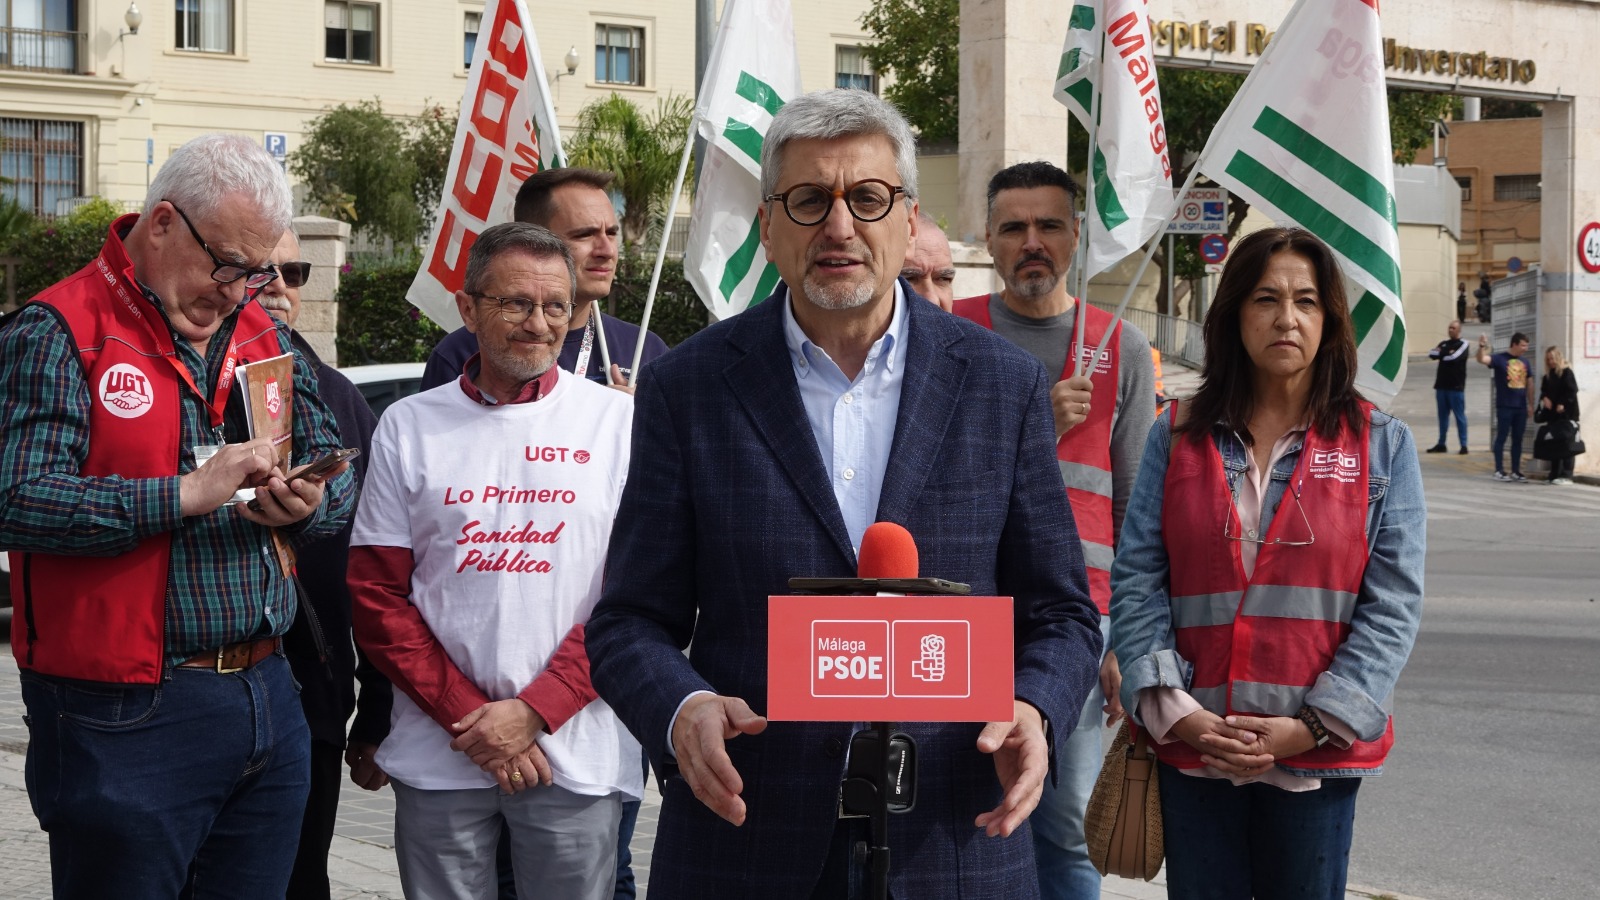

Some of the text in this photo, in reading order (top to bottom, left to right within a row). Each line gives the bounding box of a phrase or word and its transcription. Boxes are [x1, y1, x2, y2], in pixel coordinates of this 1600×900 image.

[1187, 207, 1197, 216] 20
[106, 371, 146, 396] UGT
[525, 446, 570, 463] UGT
[1314, 451, 1356, 468] CCOO
[444, 485, 576, 506] Lo Primero
[456, 520, 566, 546] Sanidad
[456, 548, 554, 574] Pública
[818, 637, 866, 653] Málaga
[818, 656, 883, 680] PSOE
